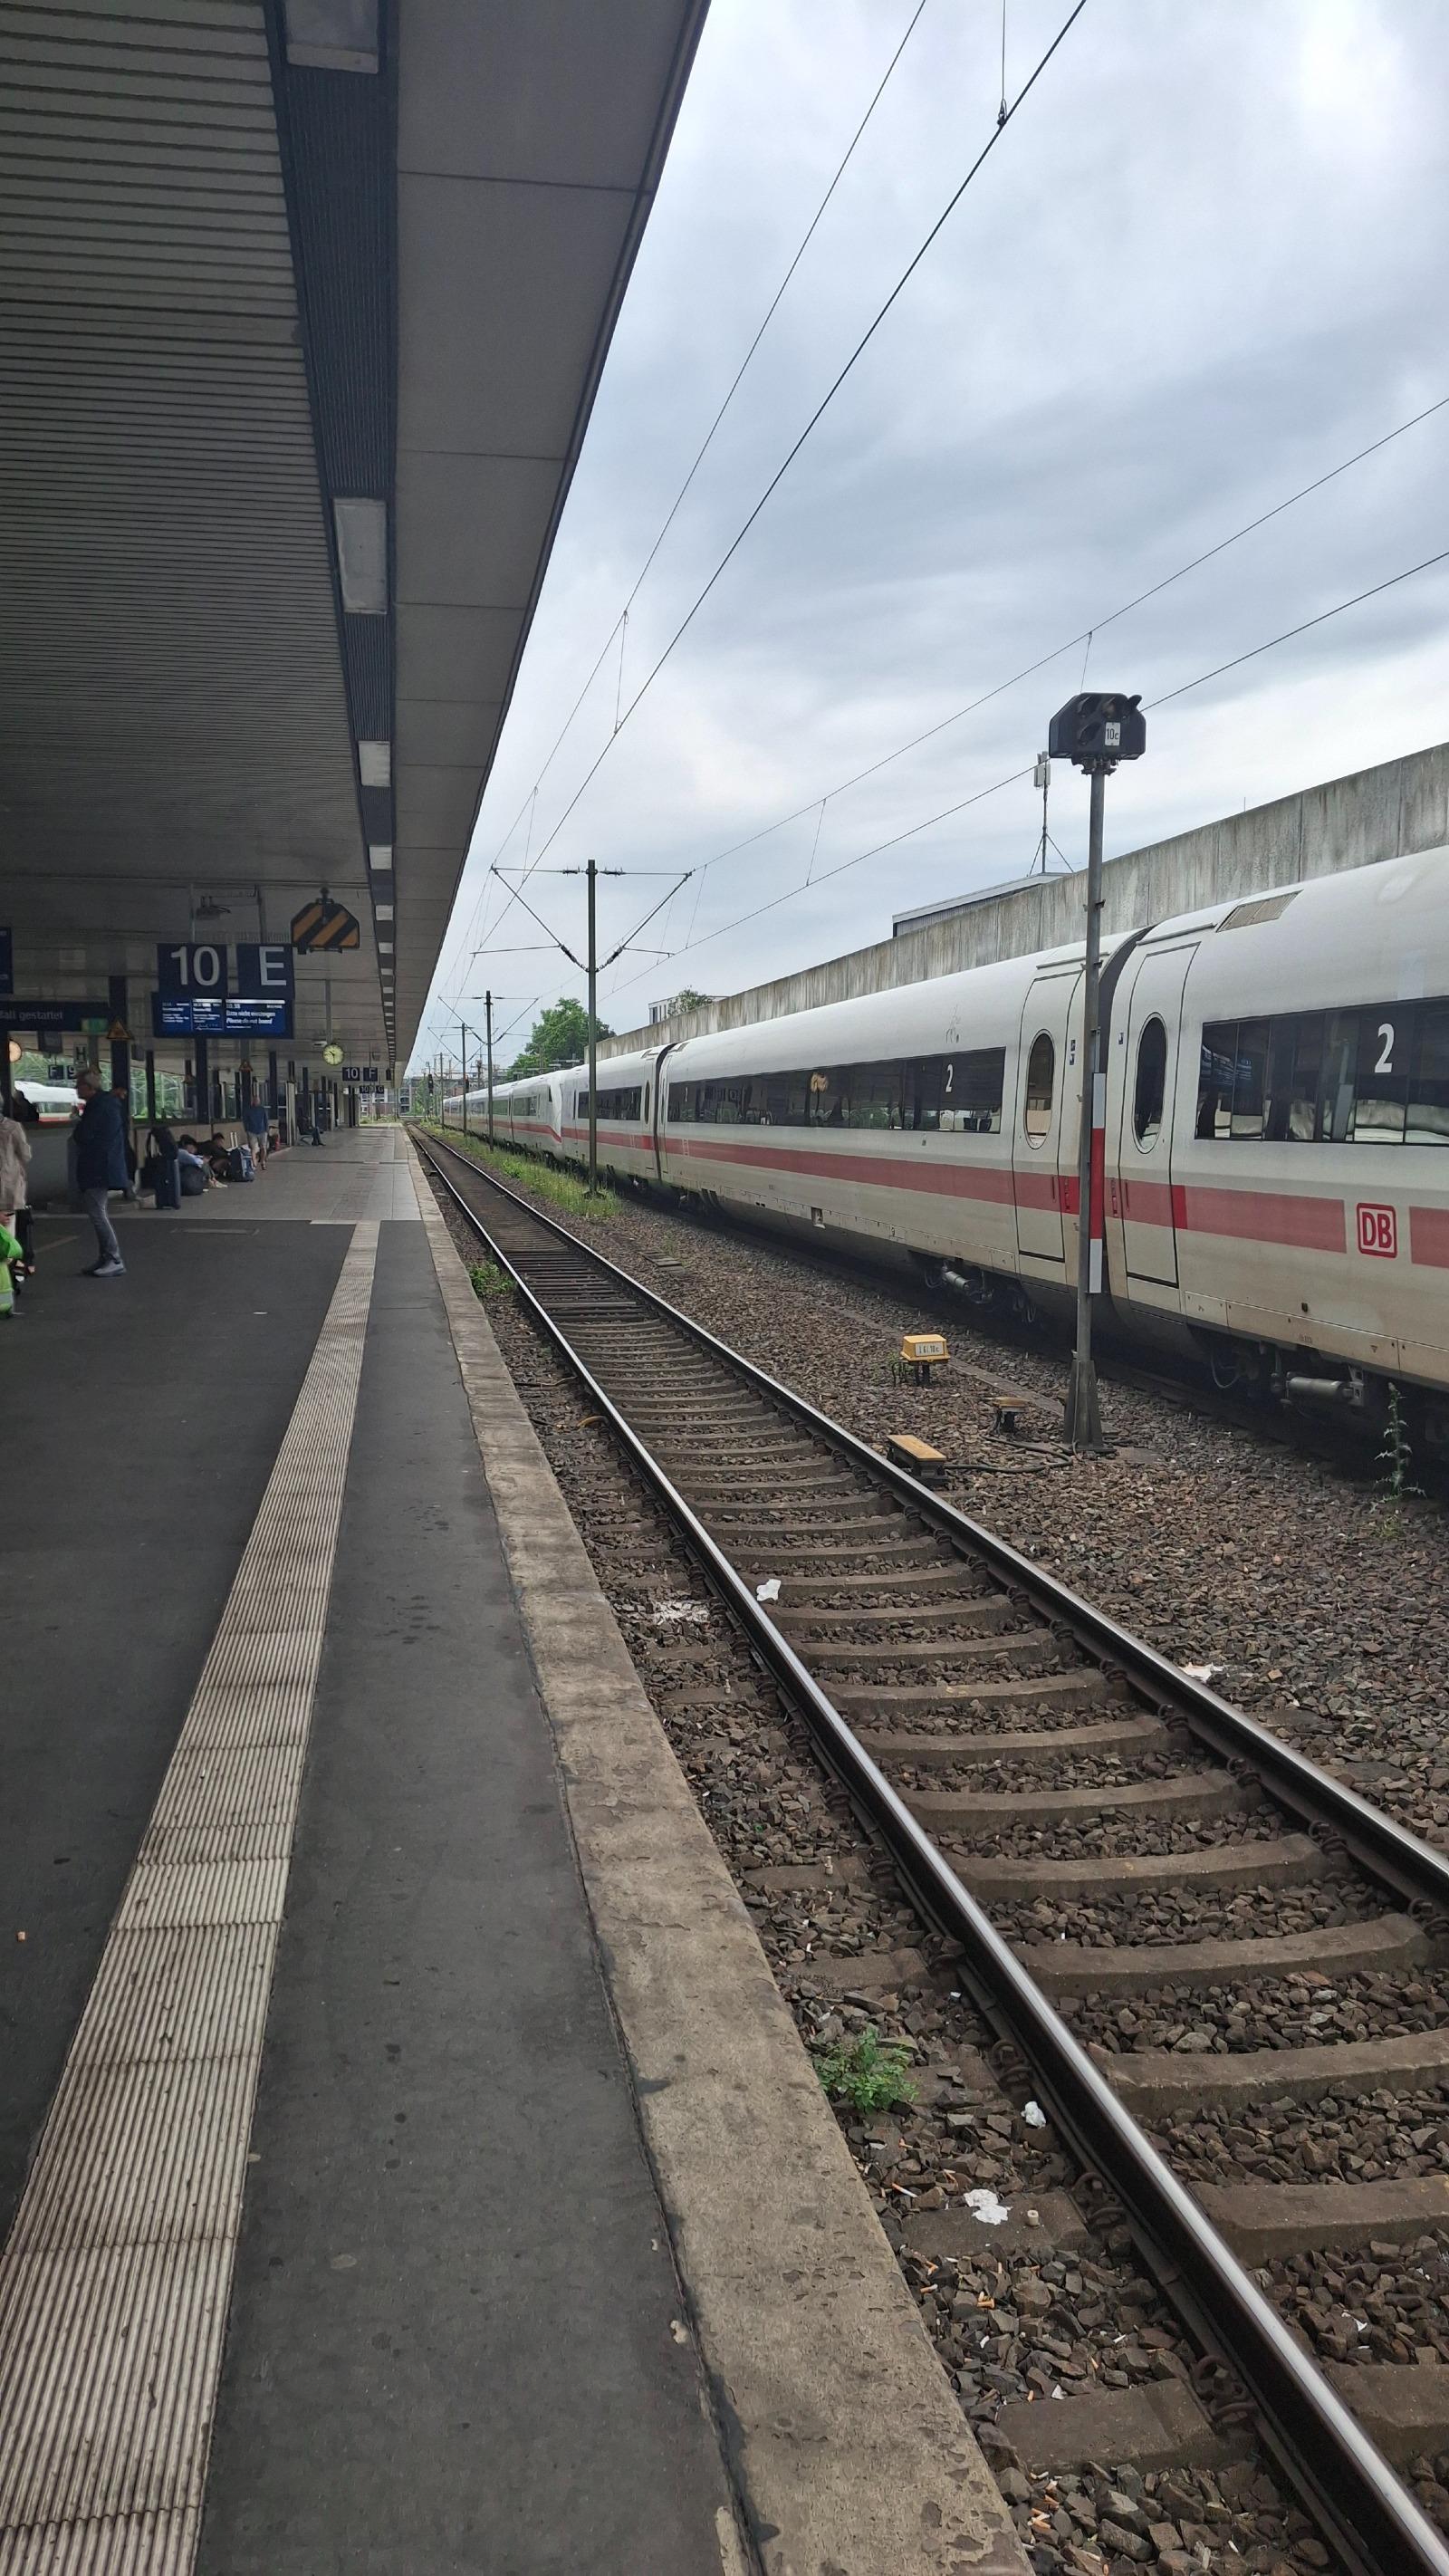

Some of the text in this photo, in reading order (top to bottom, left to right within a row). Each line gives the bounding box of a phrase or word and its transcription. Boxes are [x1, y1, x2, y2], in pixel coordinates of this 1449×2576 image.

[1107, 728, 1118, 740] 10c
[170, 946, 287, 986] 10 E
[76, 1046, 86, 1061] H
[1374, 1023, 1396, 1073] 2
[50, 1065, 57, 1076] F
[346, 1068, 376, 1079] 10 F
[945, 1063, 954, 1092] 2
[1361, 1211, 1393, 1249] DB
